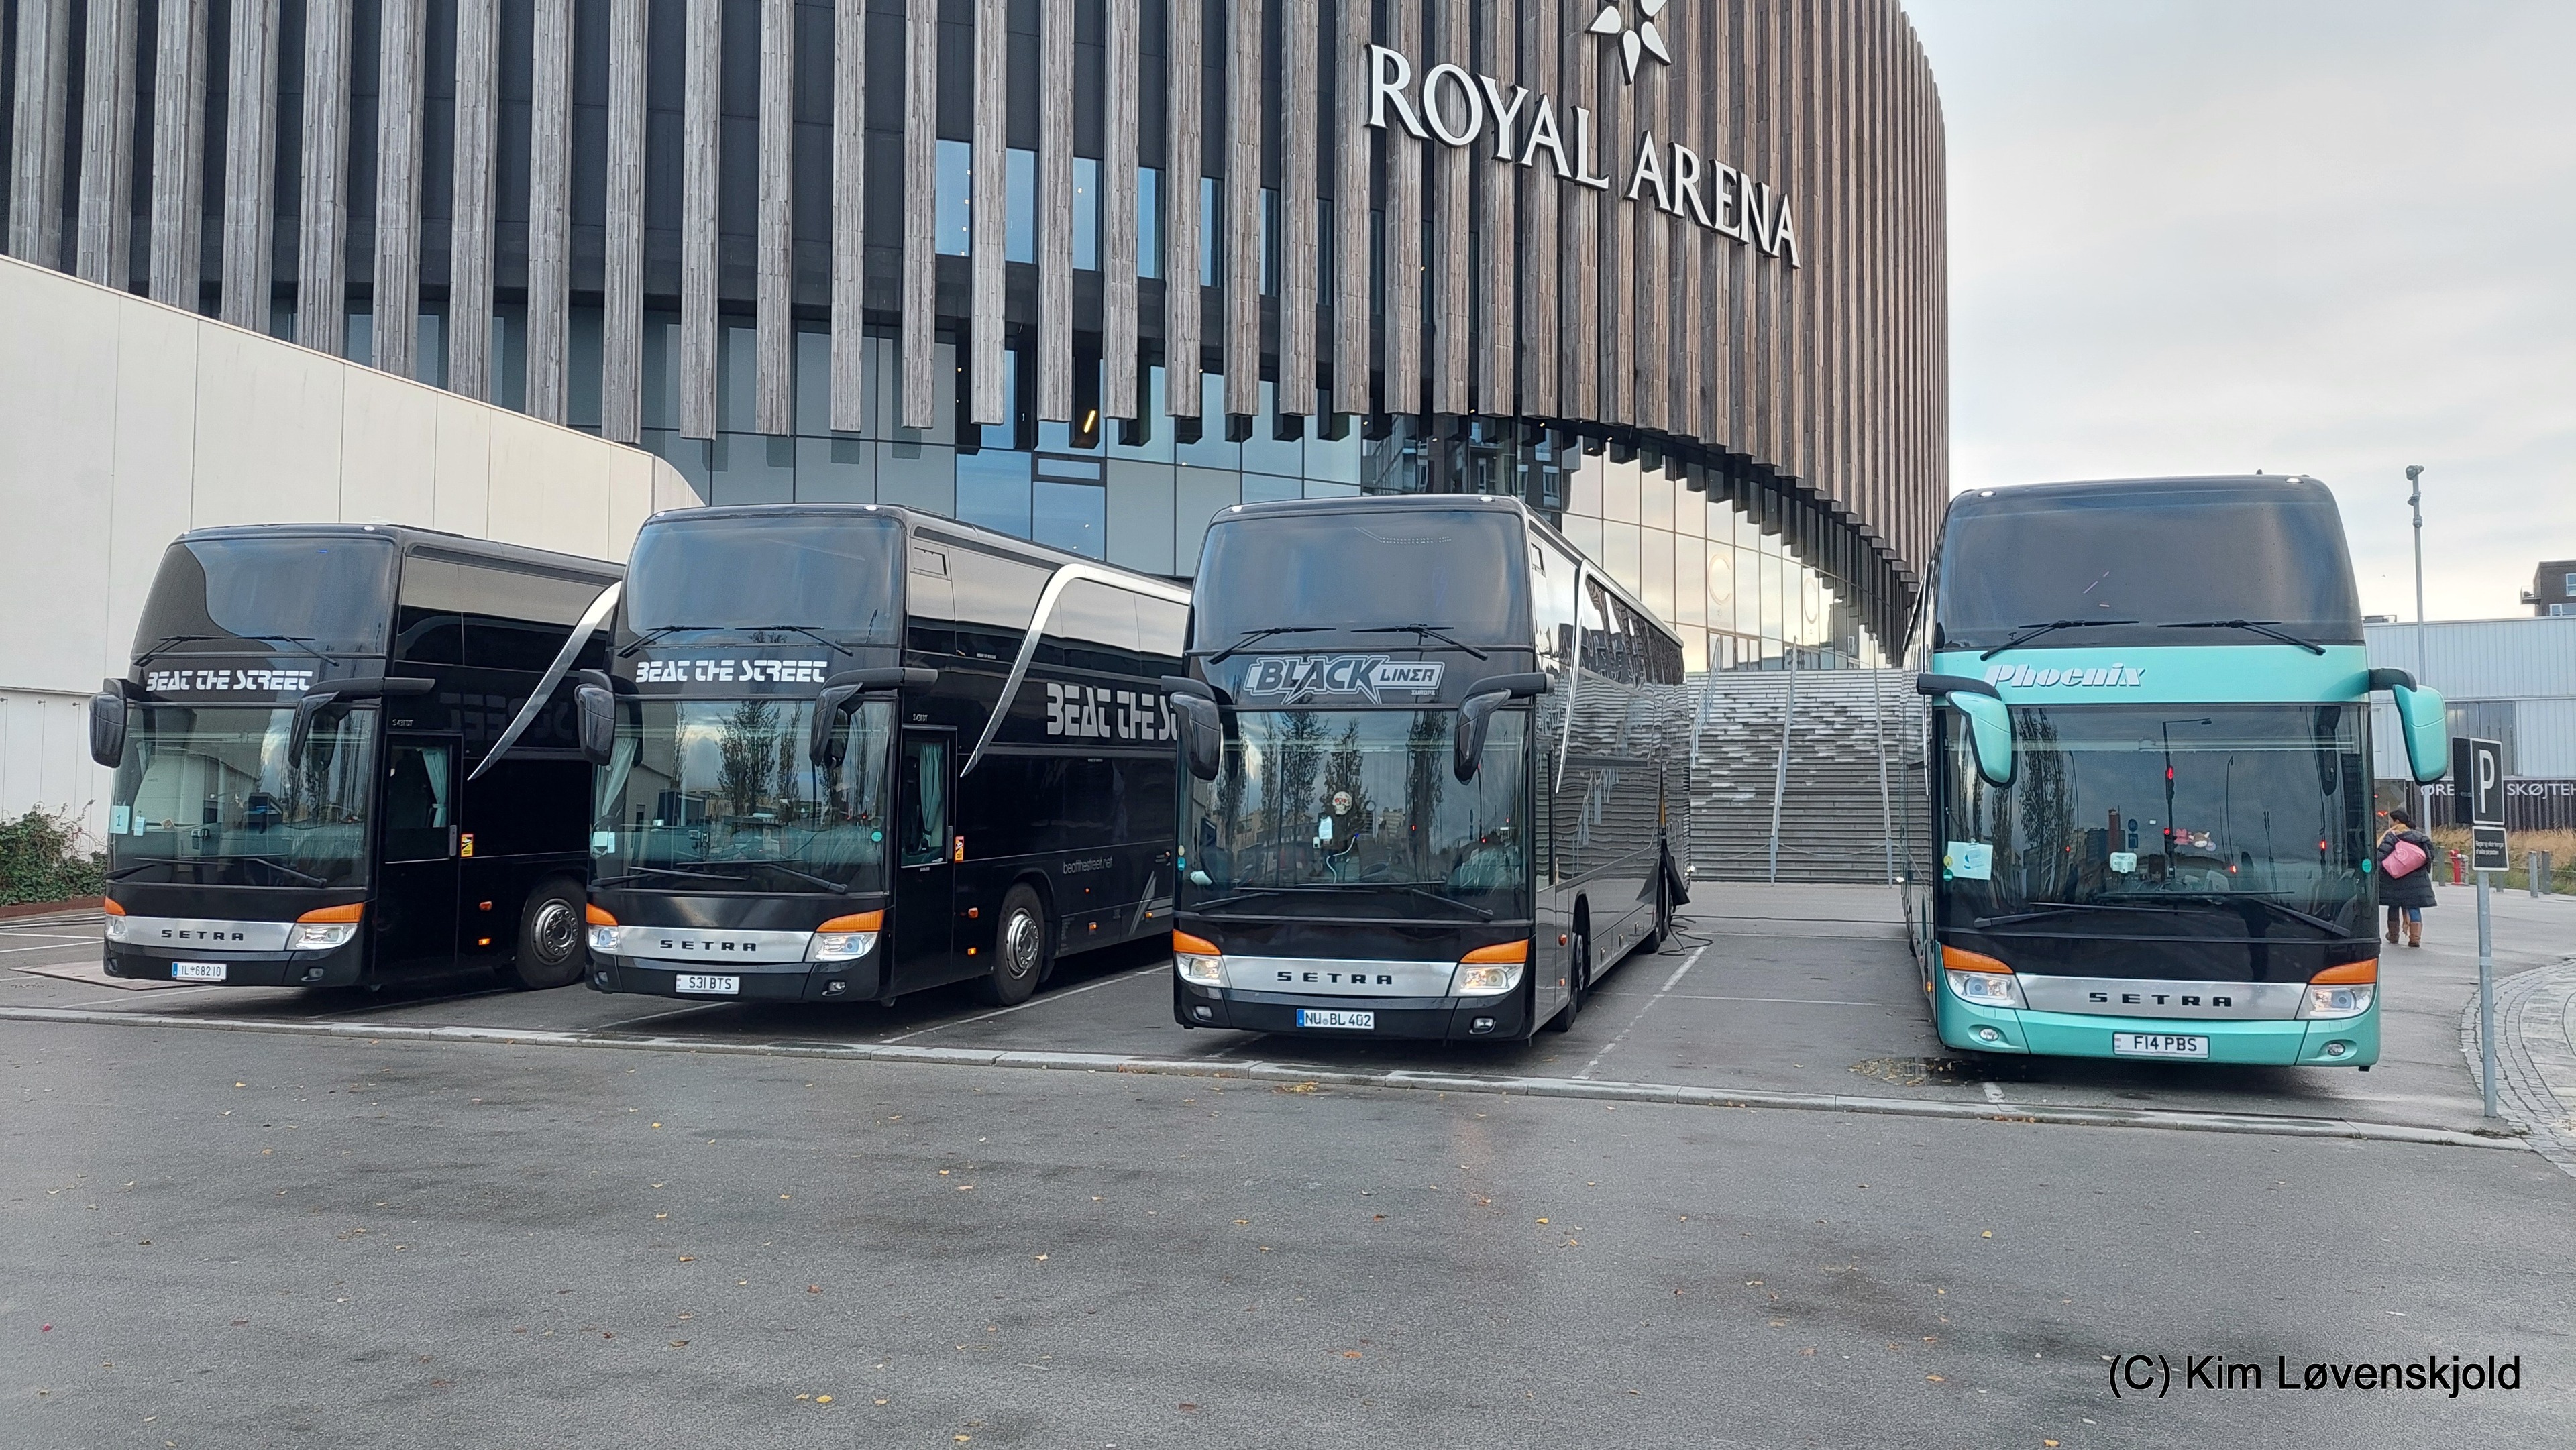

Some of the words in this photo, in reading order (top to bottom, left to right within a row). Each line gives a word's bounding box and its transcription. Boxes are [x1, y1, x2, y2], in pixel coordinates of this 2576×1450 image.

[1364, 43, 1609, 191] ROYAL
[1623, 130, 1802, 270] ARENA
[637, 661, 690, 683] BEAT
[695, 659, 735, 681] THE
[739, 659, 828, 683] STREET
[1983, 663, 2146, 688] Phoenix
[146, 670, 193, 691] BEAT
[195, 670, 231, 691] THE
[233, 669, 313, 691] STREET
[1253, 657, 1384, 704] BLACK
[1046, 682, 1111, 738] BEAT
[1116, 690, 1155, 740] THE
[2479, 749, 2495, 814] P
[116, 814, 121, 826] 1
[161, 930, 244, 941] SETRA
[660, 940, 757, 952] SETRA
[195, 966, 221, 977] 68210
[1277, 972, 1392, 985] SETRA
[710, 977, 731, 989] BTS
[2089, 992, 2232, 1007] SETRA
[1305, 1012, 1321, 1025] NU
[1330, 1013, 1346, 1026] BL
[1348, 1014, 1371, 1027] 402
[2134, 1036, 2159, 1050] F14
[2165, 1036, 2197, 1052] PBS
